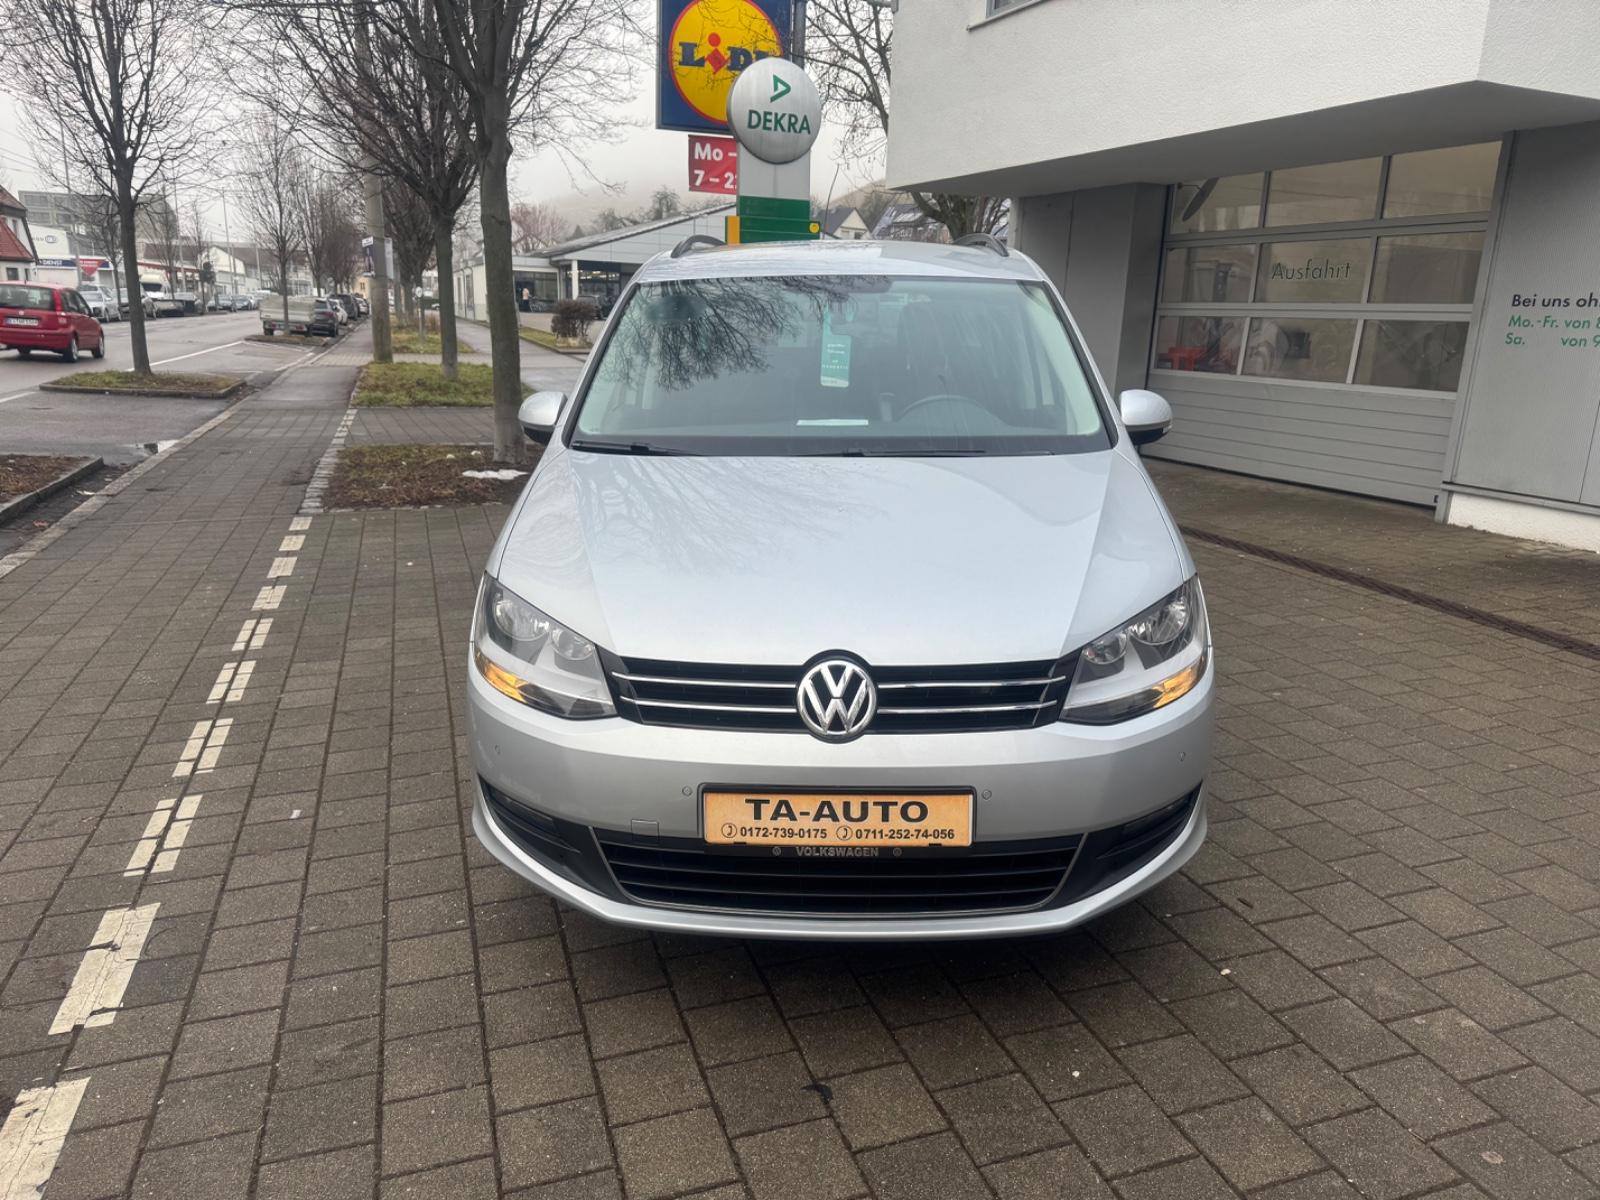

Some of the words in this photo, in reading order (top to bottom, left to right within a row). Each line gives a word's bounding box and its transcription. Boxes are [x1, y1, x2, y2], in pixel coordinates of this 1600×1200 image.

[747, 109, 811, 135] DEKRA
[694, 142, 724, 161] Mo
[694, 169, 705, 186] 7
[724, 171, 737, 189] 2
[1272, 258, 1351, 280] Ausfahrt
[1511, 293, 1538, 308] Bei
[1541, 297, 1571, 308] uns
[1576, 292, 1600, 308] oh
[1564, 319, 1591, 329] von
[1504, 332, 1526, 345] Sa.
[1561, 337, 1588, 347] von
[744, 798, 929, 823] TA-AUTO
[740, 827, 828, 839] 0172-739-0175
[855, 828, 955, 840] 0711-252-74-056
[796, 846, 879, 857] VOLKSWAGEN
